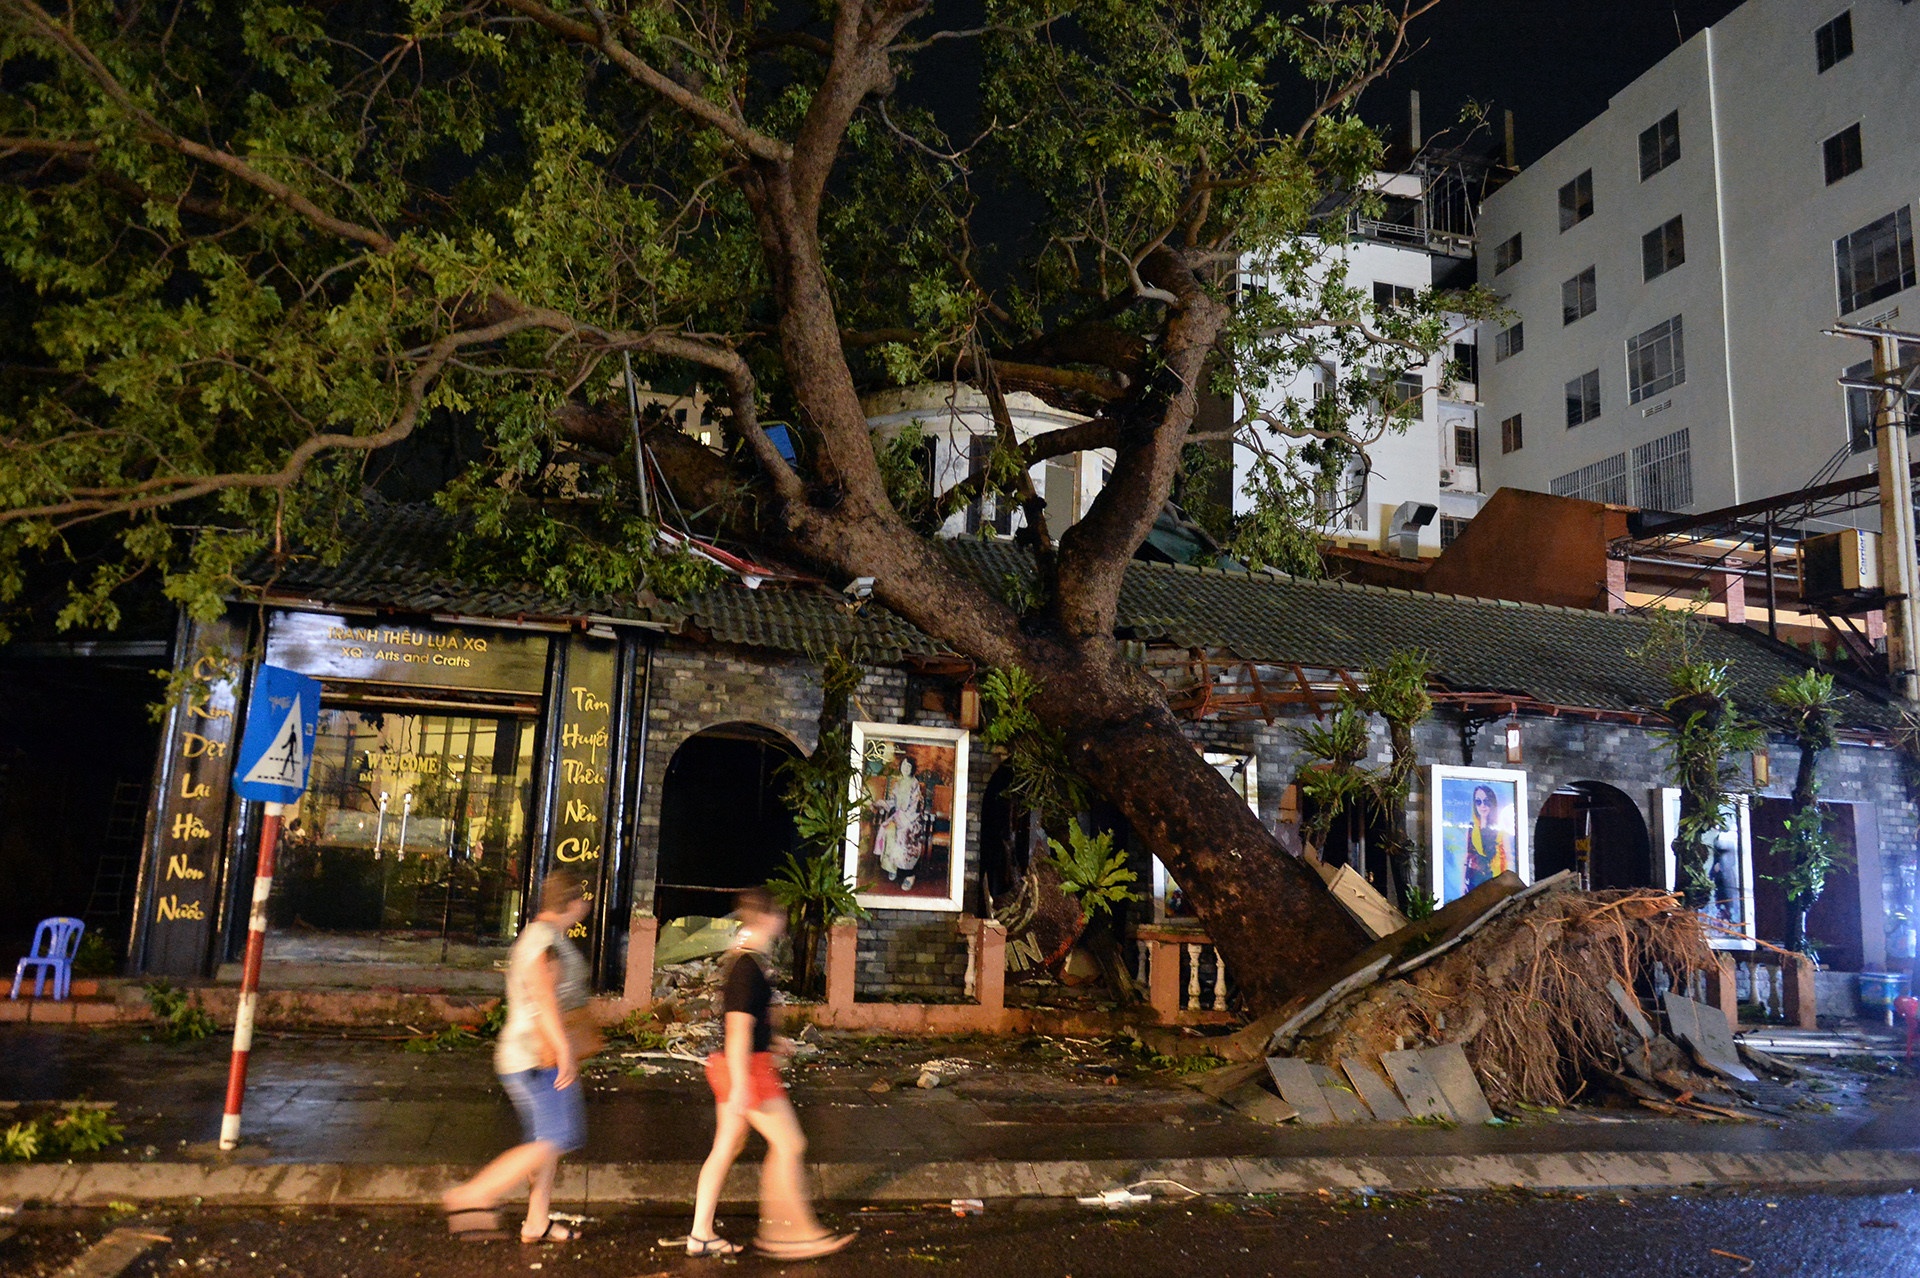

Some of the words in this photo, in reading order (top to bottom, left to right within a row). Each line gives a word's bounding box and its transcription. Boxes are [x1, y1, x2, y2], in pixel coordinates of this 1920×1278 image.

[1859, 537, 1867, 575] Carrier
[327, 626, 378, 643] TRANH
[383, 629, 423, 646] THÊU
[427, 634, 458, 651] LỤA
[463, 637, 488, 652] XQ
[341, 647, 363, 659] XQ
[375, 649, 400, 662] Arts
[403, 653, 429, 664] and
[432, 653, 471, 667] Crafts
[571, 686, 609, 715] Tâm
[562, 723, 608, 764] Huyết
[563, 759, 605, 784] Thêu
[181, 773, 210, 800] Lại
[564, 798, 598, 825] Nên
[172, 813, 211, 841] Hồn
[556, 837, 600, 862] Chí
[166, 854, 205, 881] Non
[156, 895, 205, 923] Nước
